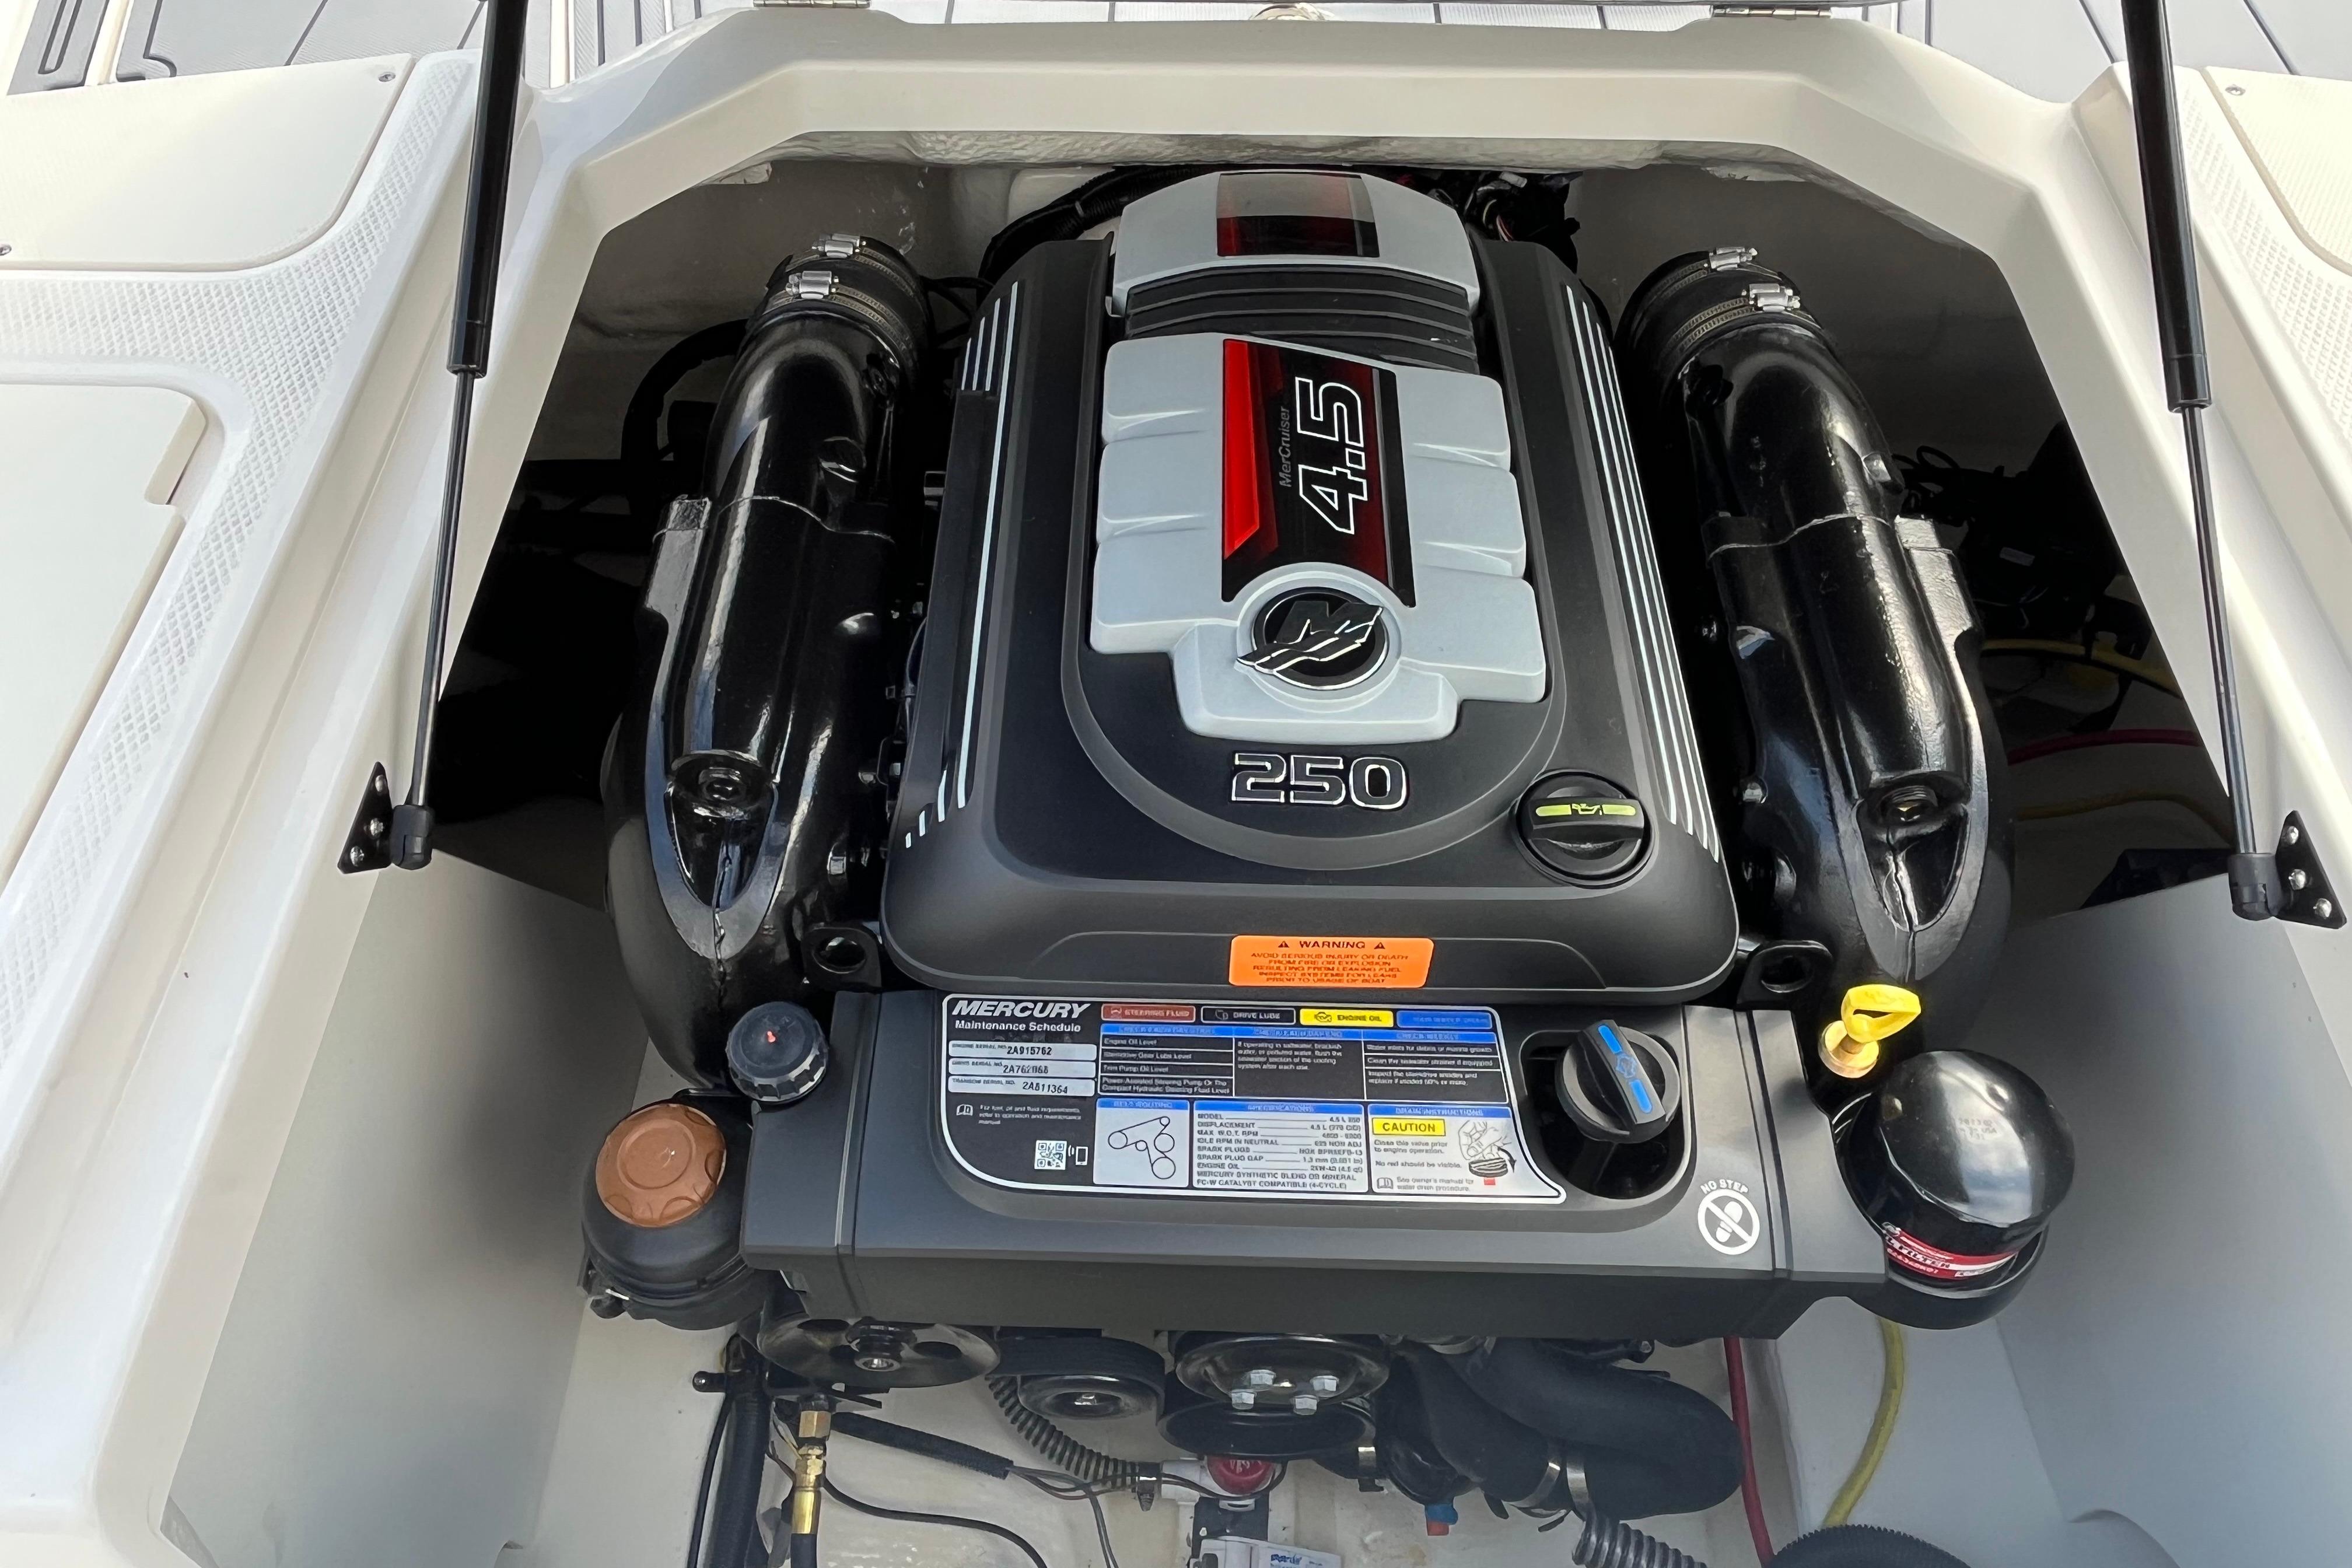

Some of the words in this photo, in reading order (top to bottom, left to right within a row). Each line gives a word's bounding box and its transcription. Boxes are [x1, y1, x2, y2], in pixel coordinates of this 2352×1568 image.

[1279, 406, 1292, 488] MerCruiser
[1295, 376, 1368, 535] 4.5
[1231, 752, 1406, 810] 250
[952, 1000, 1091, 1019] MERCURY
[956, 1020, 1025, 1031] Maintenance
[1029, 1022, 1081, 1032] Schedule
[1382, 1122, 1435, 1132] CAUTION
[1700, 1180, 1717, 1195] NO
[1719, 1178, 1749, 1194] STEP
